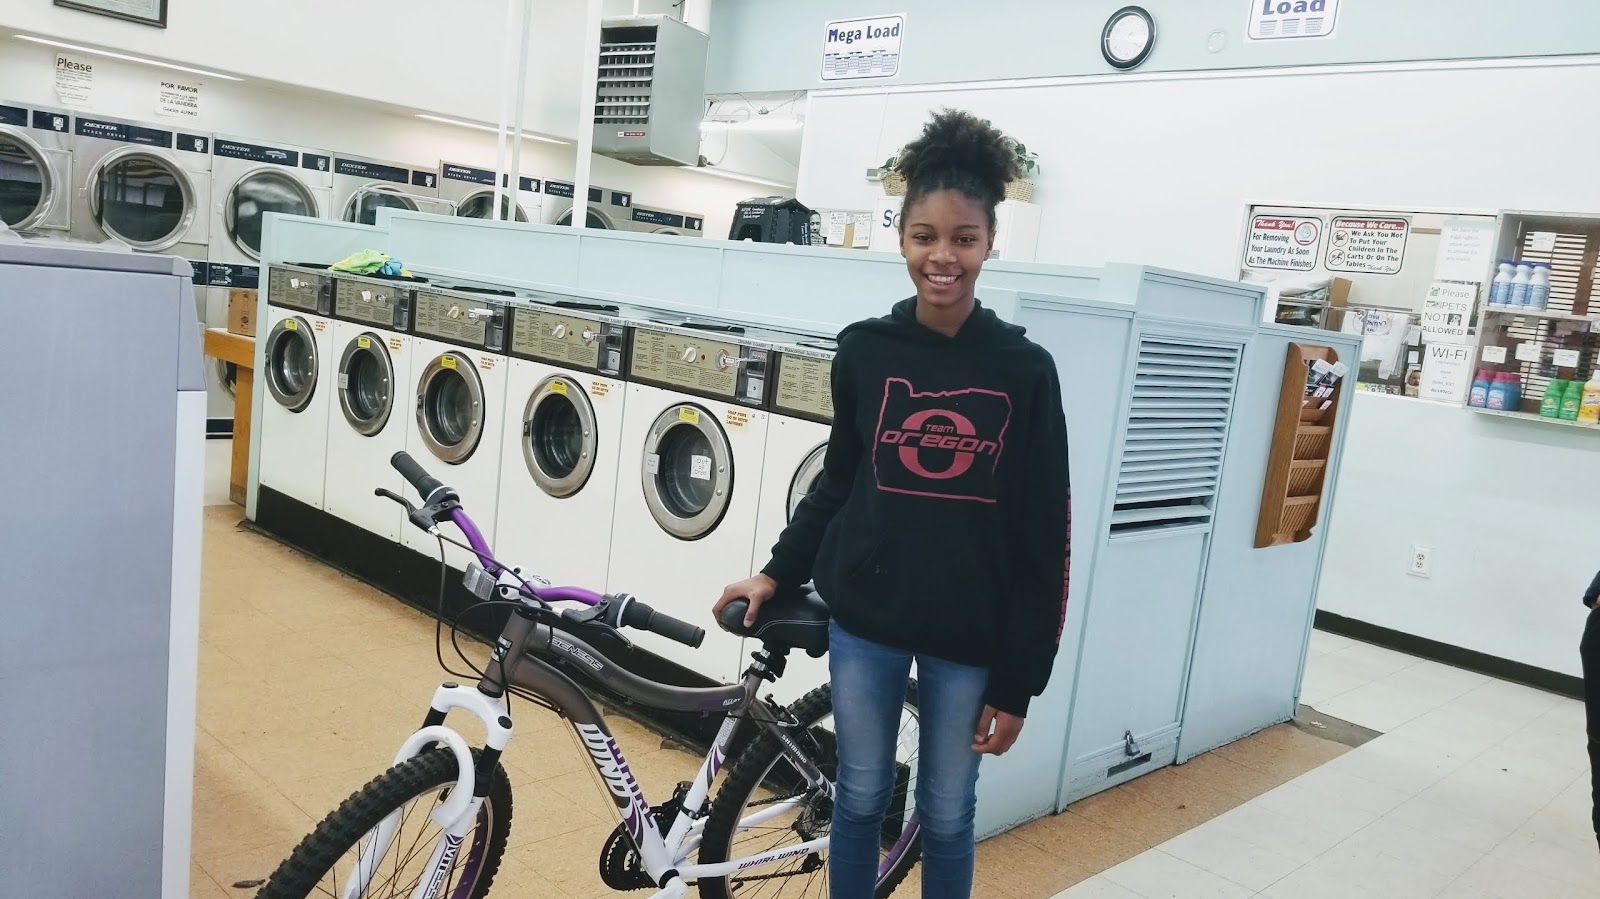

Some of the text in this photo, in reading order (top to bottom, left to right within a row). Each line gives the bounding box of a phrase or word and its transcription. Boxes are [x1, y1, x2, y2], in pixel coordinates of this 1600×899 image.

[1263, 0, 1325, 15] Load
[828, 23, 900, 44] Mega Load
[57, 57, 92, 72] Please
[161, 81, 198, 93] POR FAVOR
[84, 122, 118, 130] DEXTER
[221, 144, 250, 152] DEXTER
[340, 162, 366, 170] DEXTER
[1336, 220, 1365, 228] Because
[1253, 232, 1290, 243] For Removing
[1252, 244, 1263, 252] Your
[1264, 245, 1286, 255] Laundry
[1296, 247, 1310, 255] Soon
[1248, 256, 1312, 267] As The Machine Finishes
[1442, 289, 1469, 298] Please
[1442, 302, 1467, 311] PETS
[1424, 312, 1448, 322] NOT
[1423, 326, 1463, 335] ALLOWED
[1433, 347, 1467, 360] WI-FI
[781, 734, 807, 764] SHIMANO
[738, 848, 810, 869] WHIRLWIND
